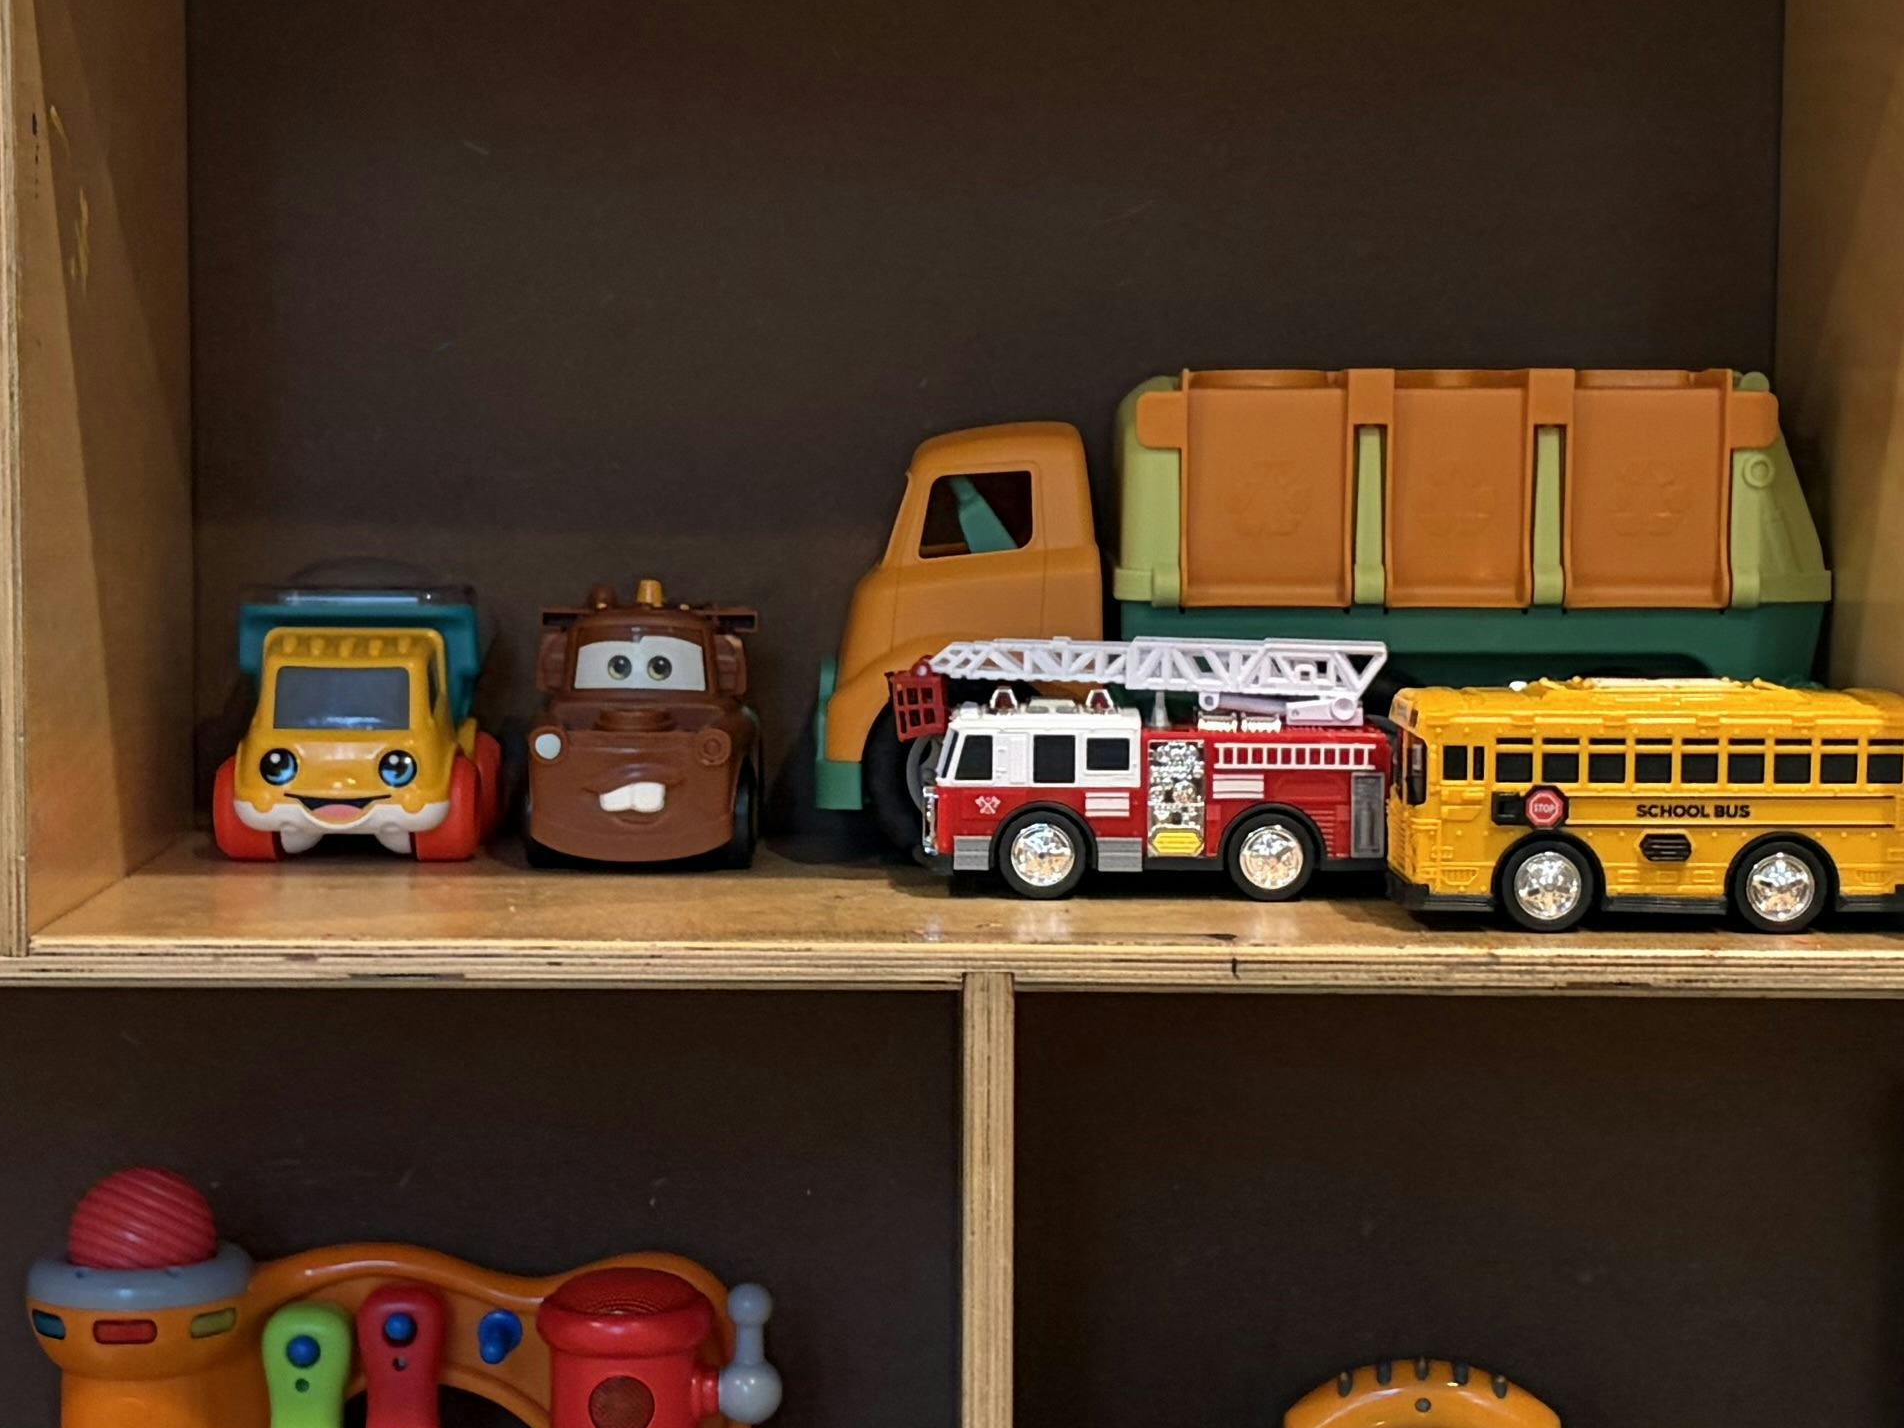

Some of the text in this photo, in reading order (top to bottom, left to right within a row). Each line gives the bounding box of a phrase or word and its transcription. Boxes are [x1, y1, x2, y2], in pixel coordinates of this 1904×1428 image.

[1533, 803, 1556, 814] STOP
[1636, 804, 1751, 819] SCHOOL BUS
